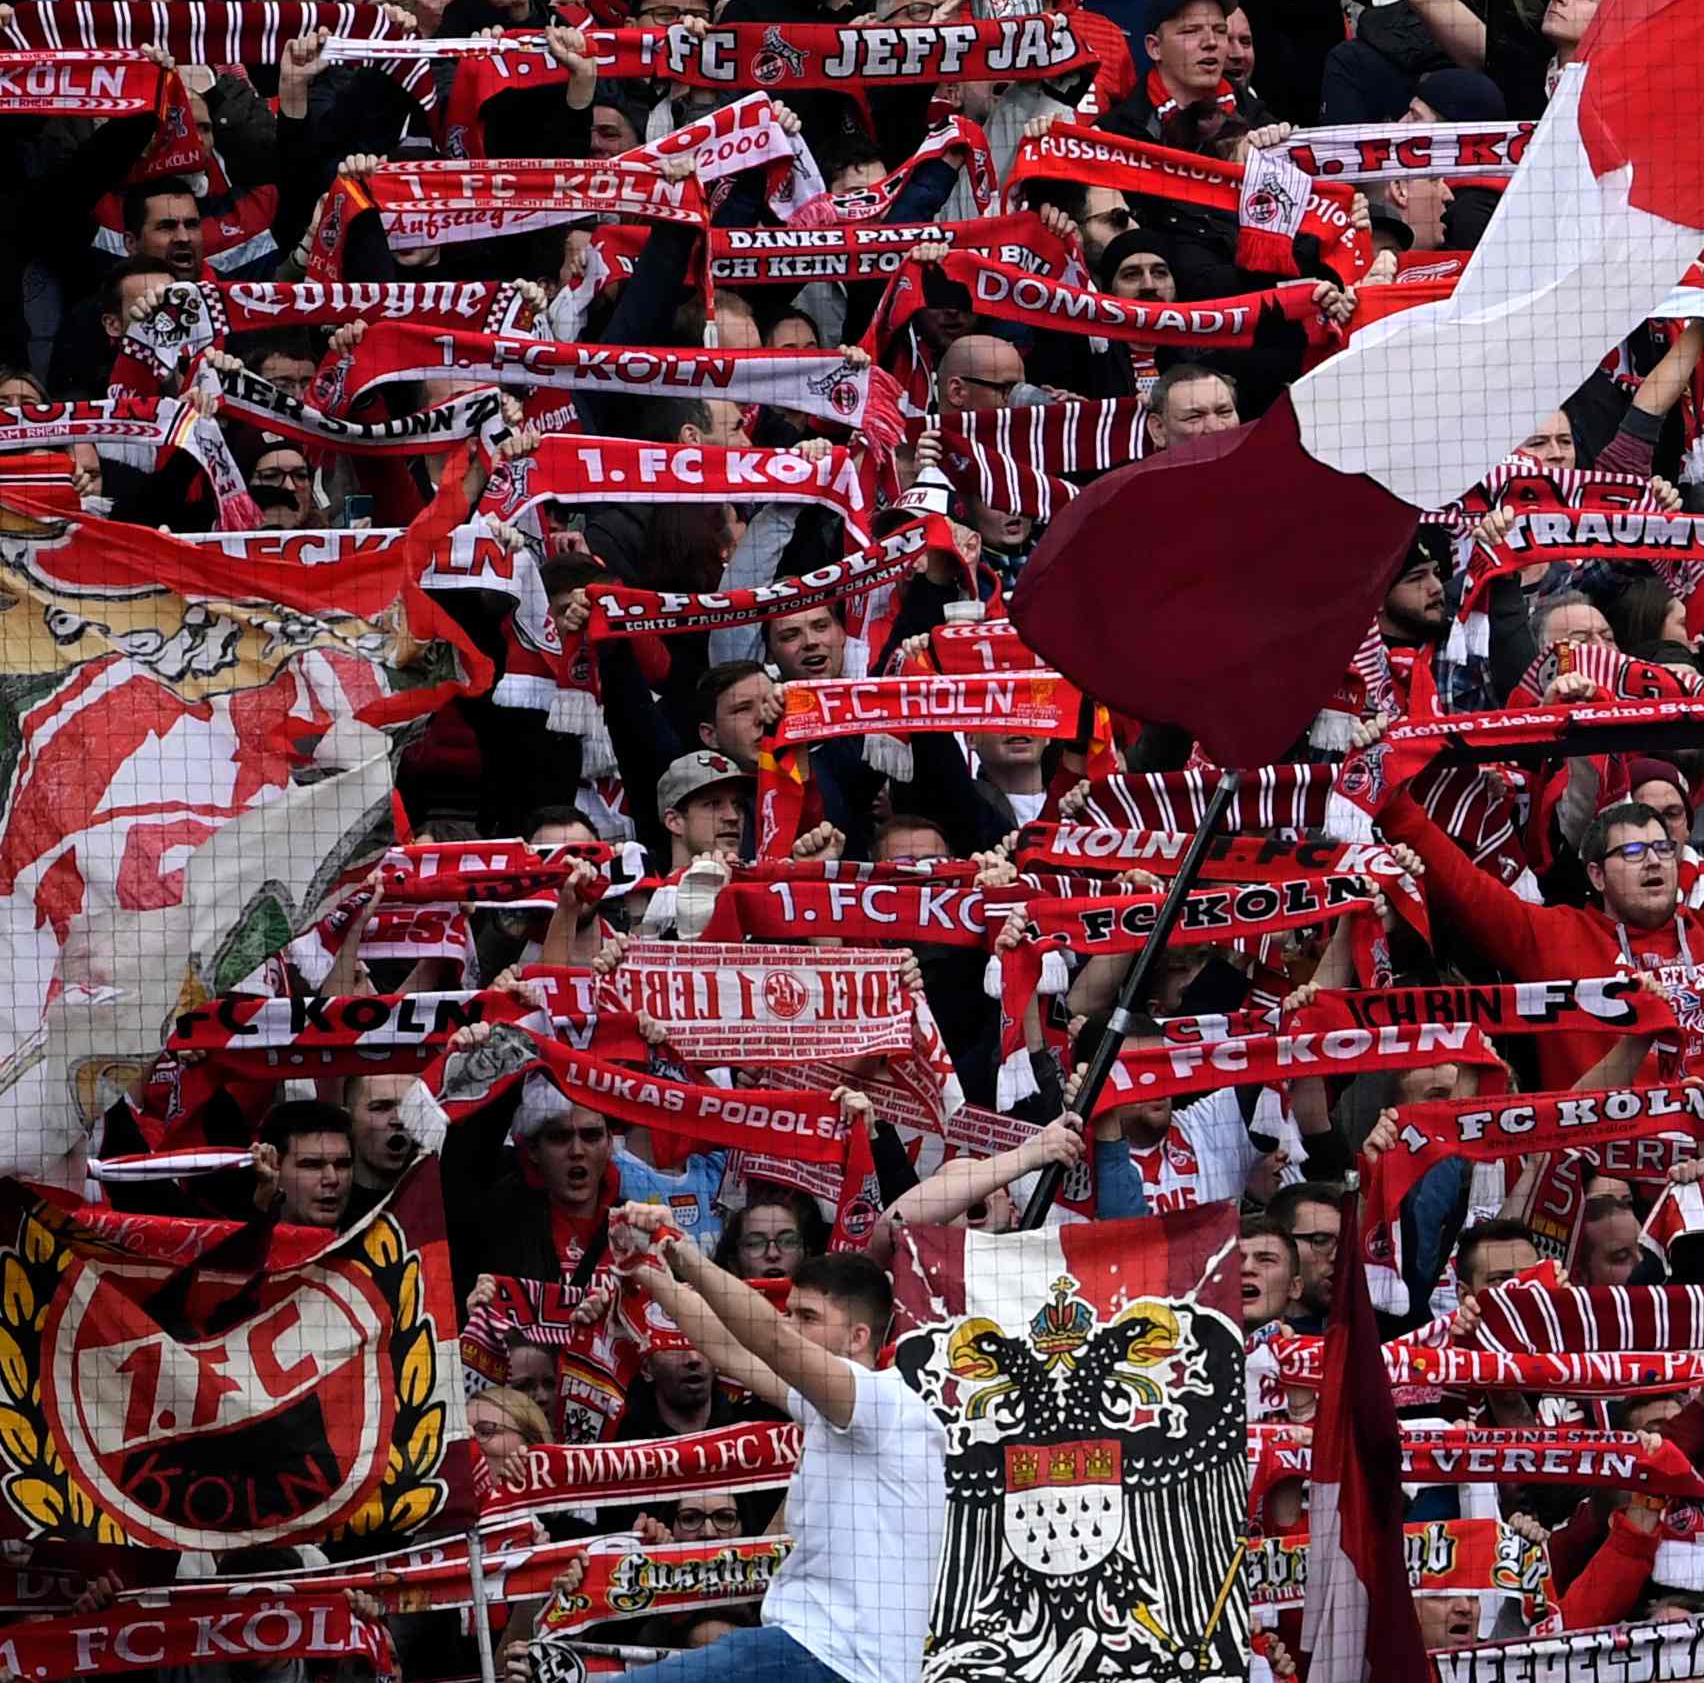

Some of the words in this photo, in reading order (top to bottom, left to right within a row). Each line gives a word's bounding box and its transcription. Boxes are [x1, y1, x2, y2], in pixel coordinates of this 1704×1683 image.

[667, 33, 734, 74] FC
[825, 26, 978, 76] JEFF
[1360, 138, 1431, 170] FC
[460, 174, 521, 201] FC
[554, 168, 684, 206] KÖLN
[729, 230, 845, 247] DANKE
[977, 271, 1252, 334] DOMSTADT
[435, 337, 475, 367] 1.
[491, 342, 556, 376] FC
[574, 346, 736, 387] KÖLN
[578, 450, 624, 482] 1.
[638, 449, 709, 480] FC
[654, 591, 717, 613] FC
[822, 682, 890, 717] F.C.
[908, 674, 1014, 714] KÖLN
[1390, 721, 1476, 741] Meine
[1571, 703, 1654, 720] Meine
[771, 884, 814, 922] 1.
[829, 887, 898, 922] FC
[1173, 1040, 1247, 1074] FC
[566, 1067, 684, 1111] LUKAS
[1458, 1109, 1533, 1140] FC
[564, 1440, 683, 1481] IMMER
[1456, 1448, 1648, 1479] VEREIN.
[70, 1622, 166, 1671] FC
